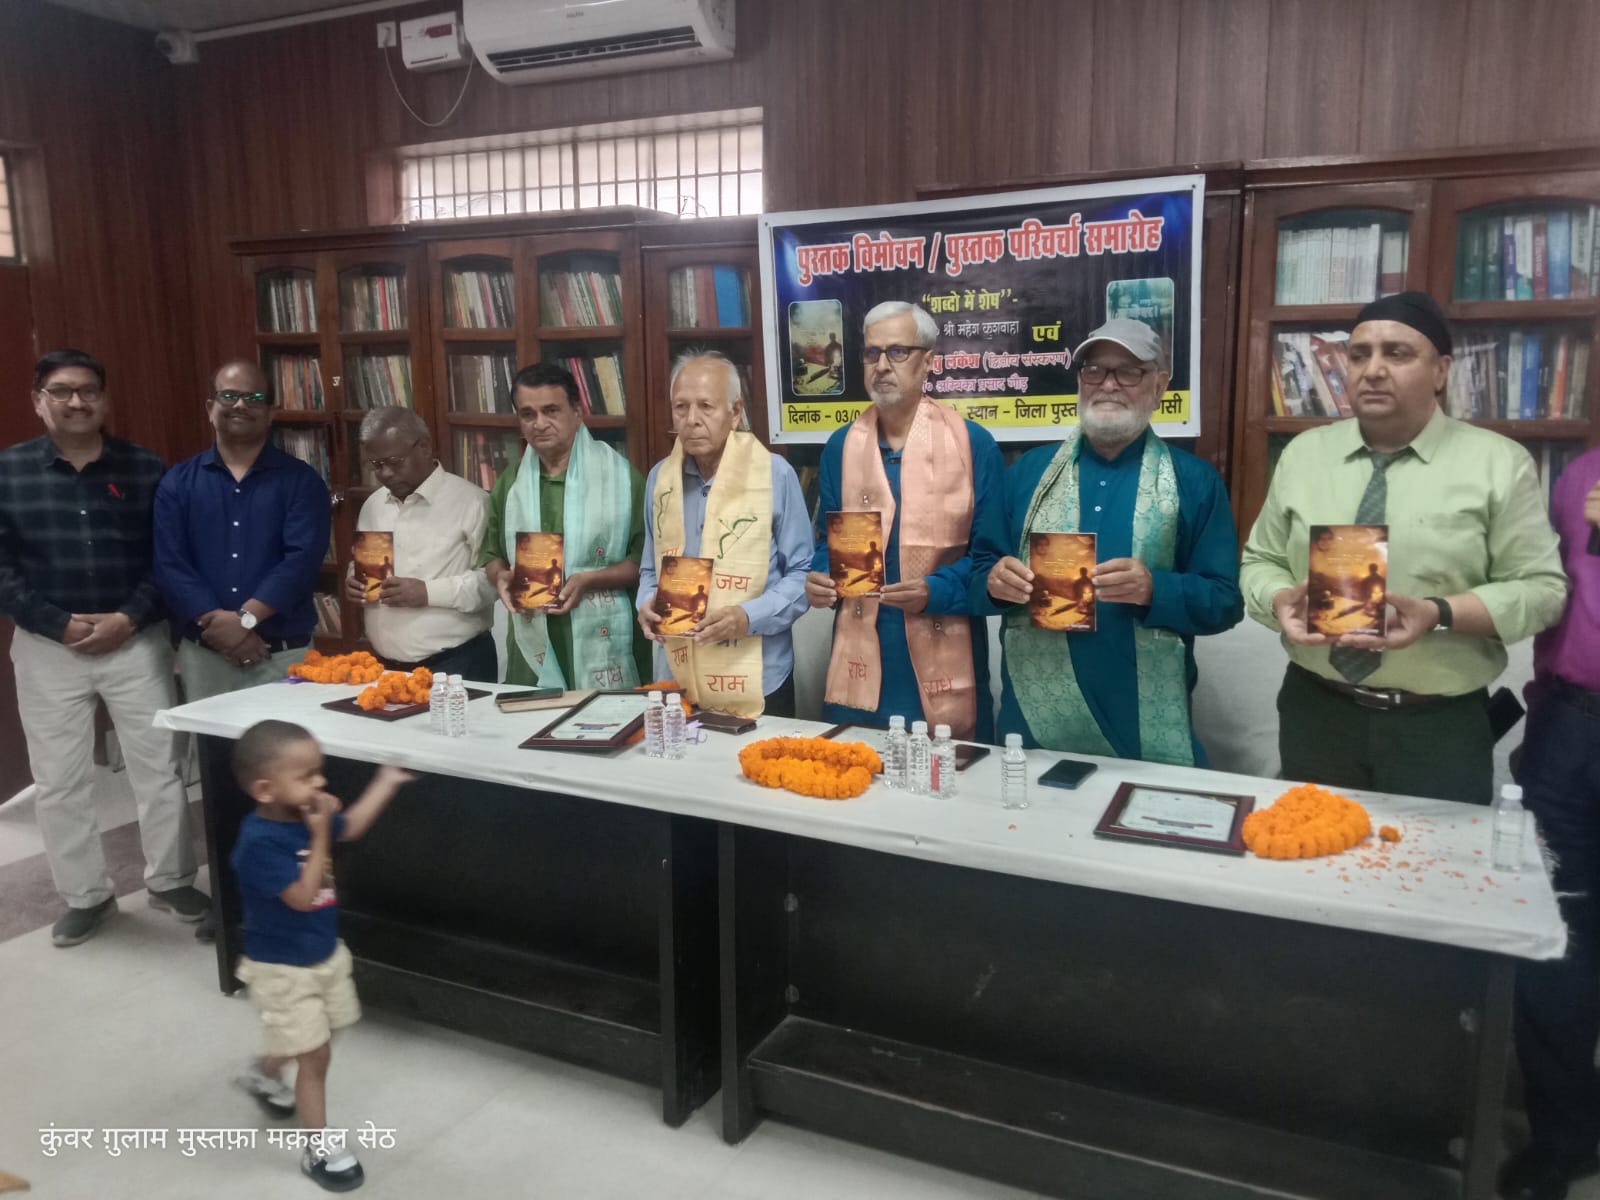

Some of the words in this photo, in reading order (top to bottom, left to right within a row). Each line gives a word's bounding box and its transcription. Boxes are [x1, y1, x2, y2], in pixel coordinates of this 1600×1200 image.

[796, 243, 850, 286] पुस्तक
[852, 231, 926, 272] विमोचन
[944, 230, 1005, 276] पुस्तक
[1007, 213, 1081, 260] परिचर्चा
[1084, 209, 1164, 255] समारोह
[964, 289, 976, 311] में
[943, 321, 954, 336] श्री
[957, 321, 979, 338] महेश
[1031, 321, 1062, 342] एवं
[788, 405, 821, 424] दिनांक
[835, 409, 861, 424] 03/0
[1015, 399, 1046, 419] जिला
[1051, 402, 1078, 424] पुस्त
[715, 573, 752, 592] जय
[848, 656, 868, 681] राधे
[704, 674, 749, 693] राम
